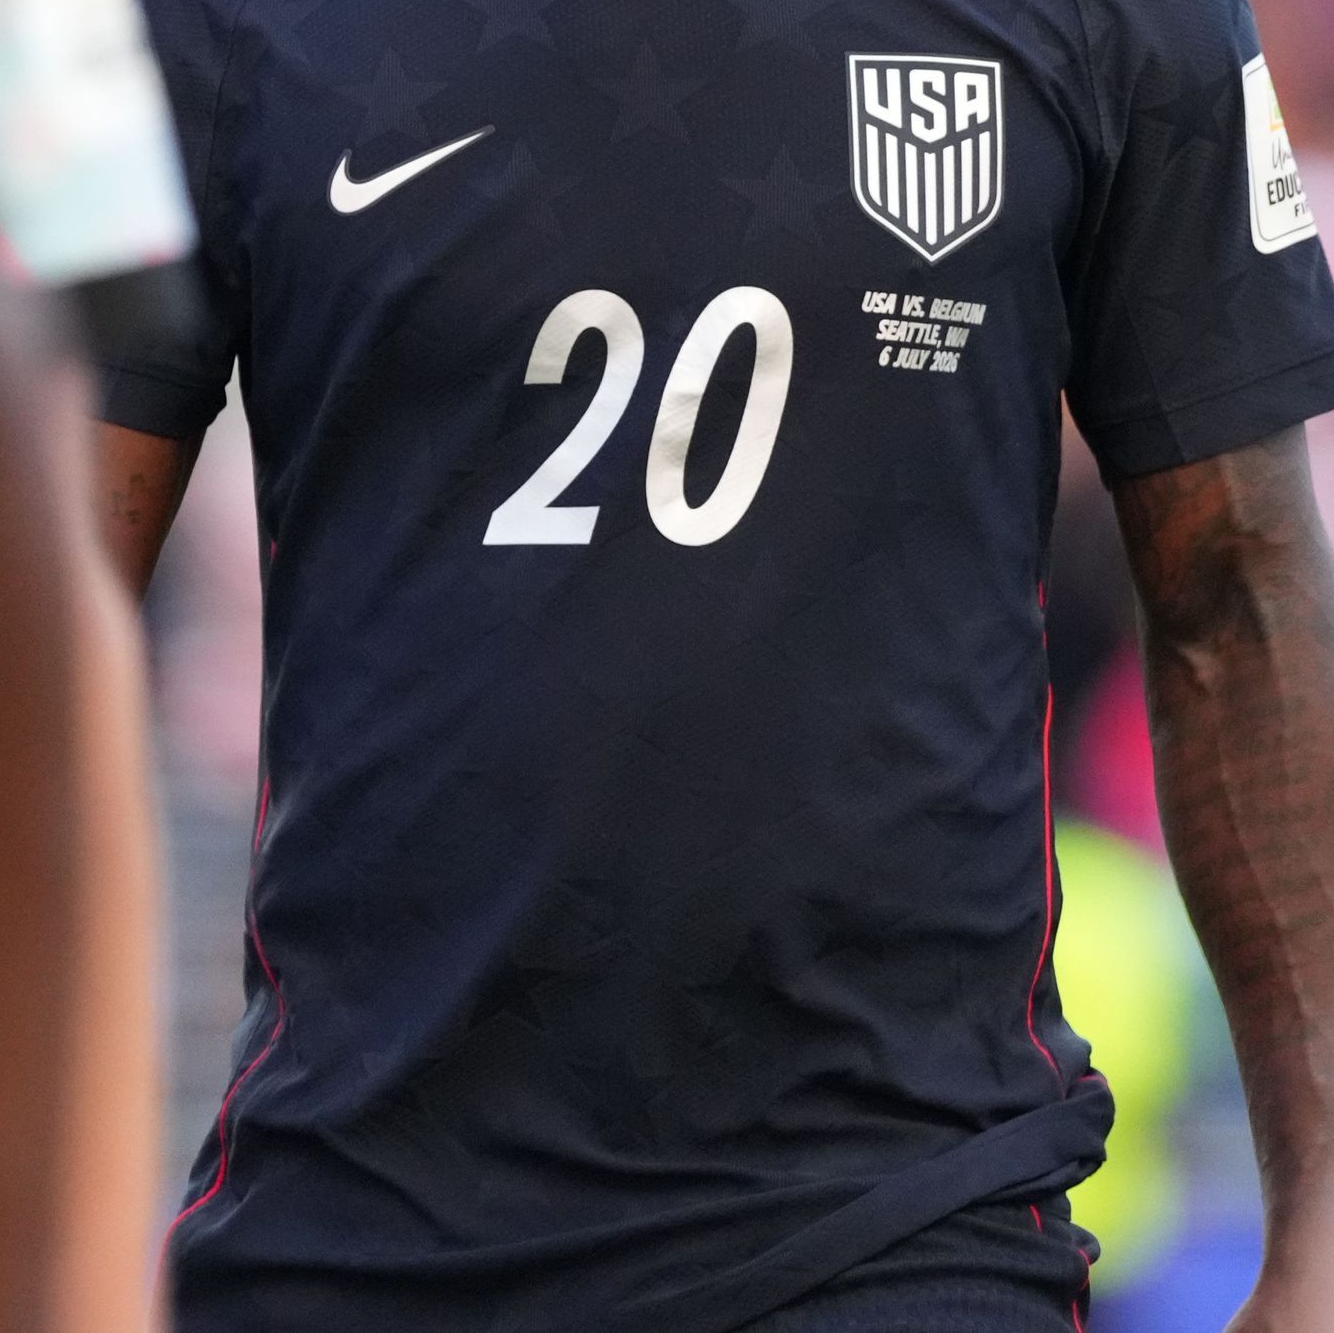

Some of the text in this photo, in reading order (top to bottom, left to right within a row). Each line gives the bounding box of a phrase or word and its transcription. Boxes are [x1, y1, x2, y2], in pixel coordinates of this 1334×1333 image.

[863, 68, 990, 143] USA
[861, 290, 987, 325] USA VS. BELGIUM
[876, 319, 970, 349] SEATTLE, WA
[878, 345, 961, 373] 6 JULY 2026
[482, 285, 794, 547] 20
